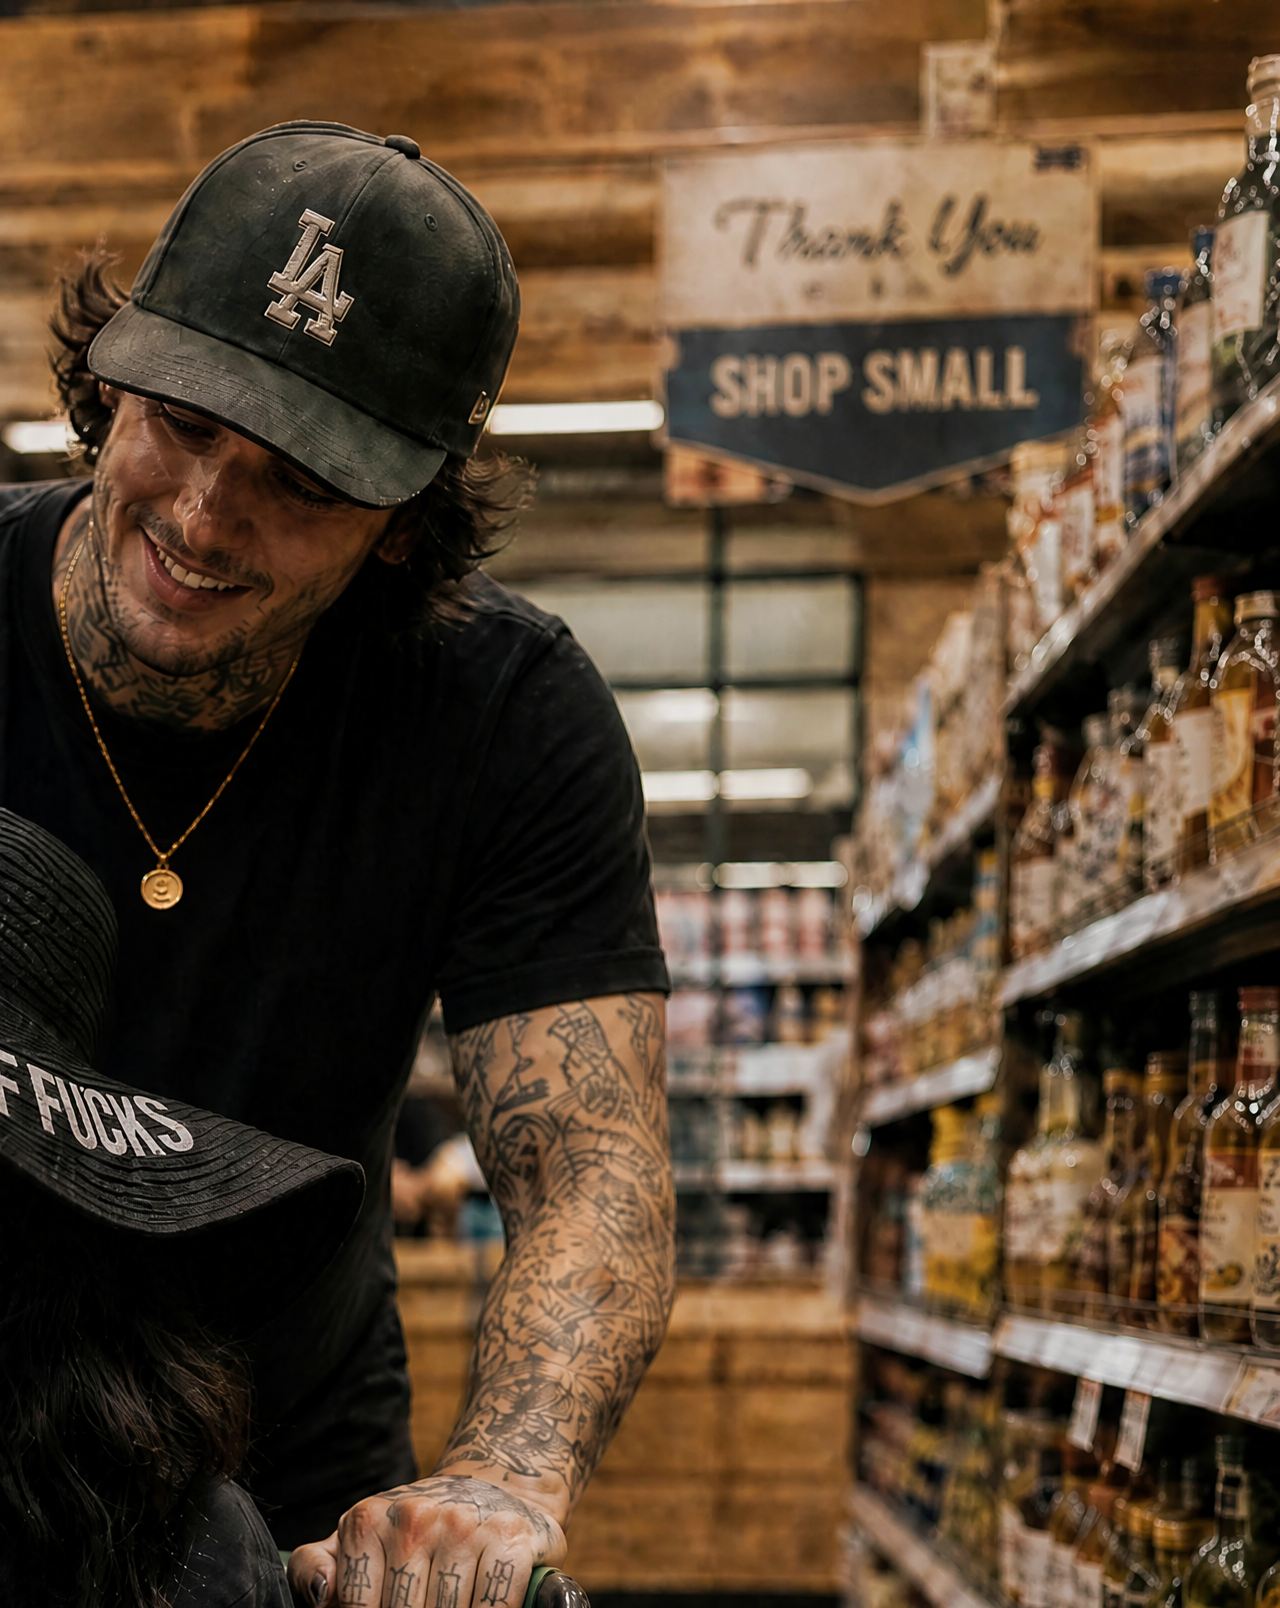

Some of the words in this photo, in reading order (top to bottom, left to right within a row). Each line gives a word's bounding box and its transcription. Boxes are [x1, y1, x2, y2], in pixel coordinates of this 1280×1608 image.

[264, 208, 355, 347] LA
[714, 196, 909, 269] Thank
[928, 192, 1043, 277] You
[709, 351, 852, 418] SHOP
[861, 345, 1040, 415] SMALL
[25, 1062, 195, 1158] FUCKS
